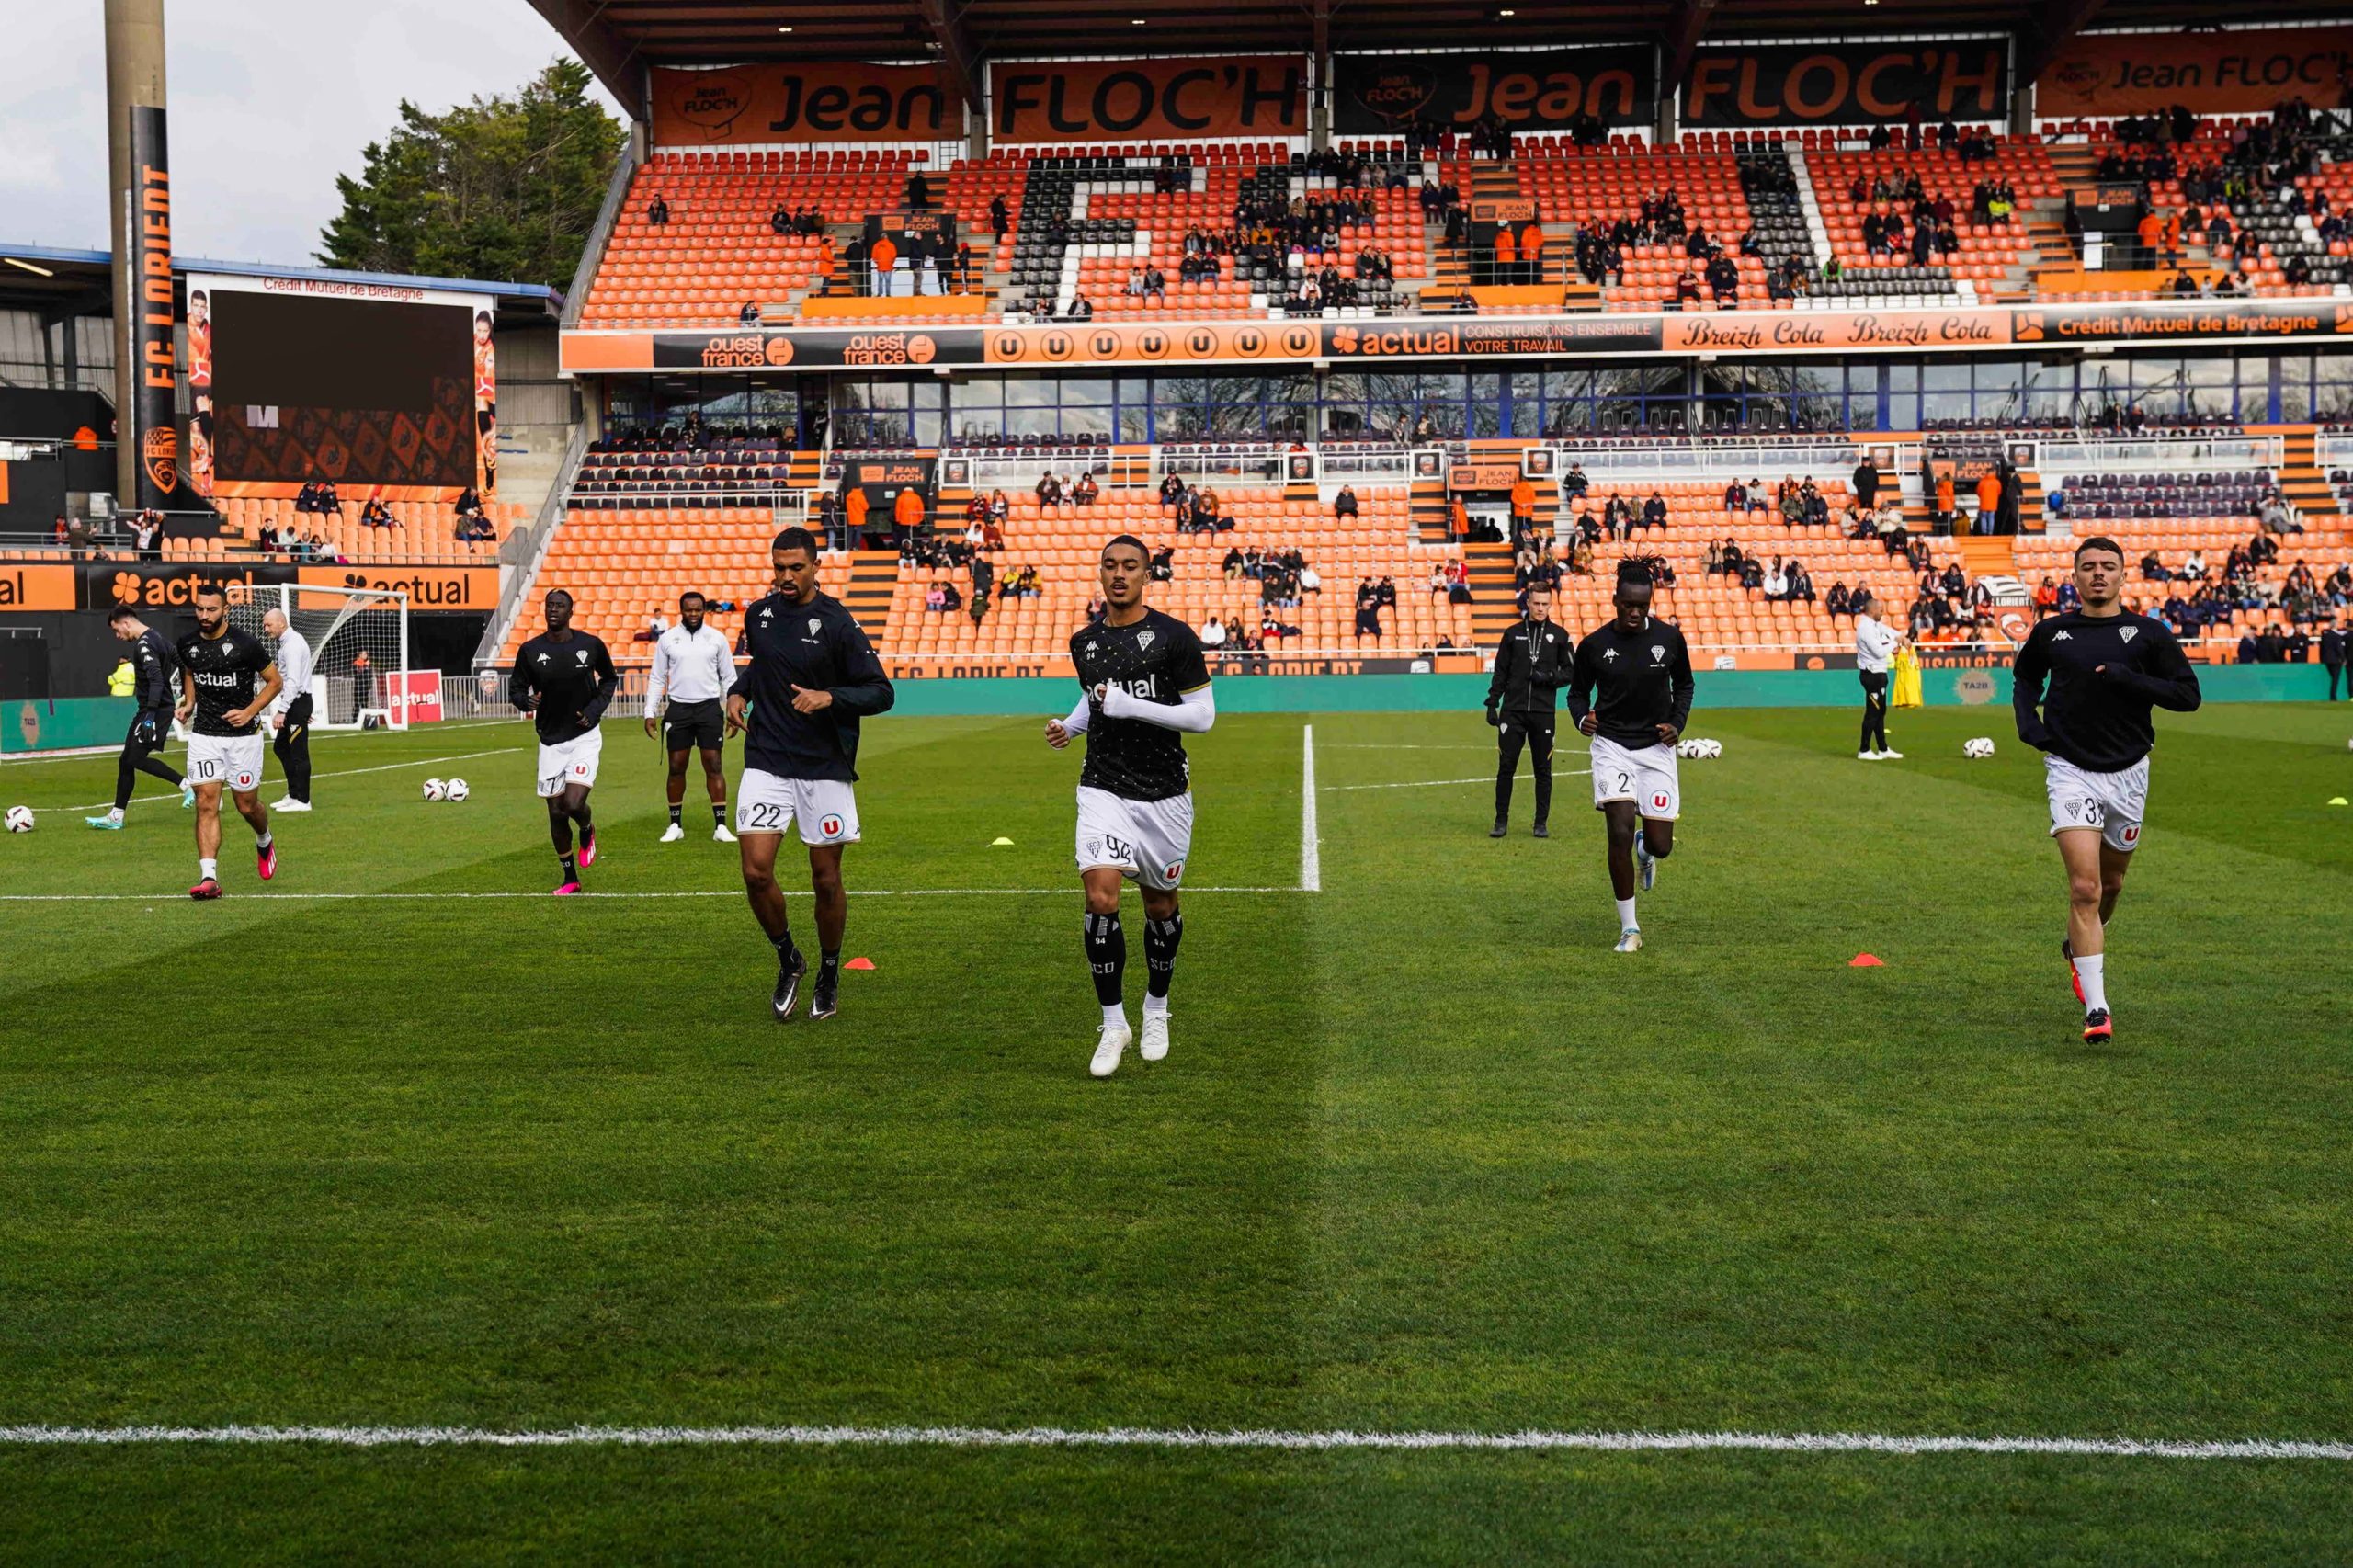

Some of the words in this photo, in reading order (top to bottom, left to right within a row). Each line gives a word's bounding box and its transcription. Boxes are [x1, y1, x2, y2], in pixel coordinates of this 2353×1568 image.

[1379, 75, 1410, 87] Jean
[1688, 50, 2000, 119] FLOC'H
[2111, 61, 2202, 89] Jean
[695, 87, 726, 98] Jean
[1000, 65, 1299, 134] FLOC'H
[1453, 63, 1634, 123] Jean
[770, 75, 945, 132] Jean
[142, 165, 174, 325] LORIENT
[305, 279, 347, 295] Mutuel
[350, 284, 365, 296] de
[369, 285, 424, 301] Bretagne
[1465, 324, 1574, 338] CONSTRUISONS
[1578, 322, 1651, 335] ENSEMBLE
[1682, 317, 1762, 349] Breizh
[1774, 319, 1825, 345] Cola
[1847, 313, 1928, 346] Breizh
[1940, 315, 1993, 341] Cola
[2058, 314, 2119, 335] Crédit
[2123, 313, 2193, 334] Mutuel
[2198, 312, 2222, 332] de
[2226, 312, 2318, 334] Bretagne
[709, 335, 764, 351] ouest
[850, 333, 905, 350] ouest
[1362, 324, 1460, 355] actual
[1465, 339, 1509, 353] VOTRE
[1512, 339, 1567, 353] TRAVAIL
[144, 340, 175, 389] FC
[702, 348, 764, 367] france
[843, 347, 905, 365] france
[892, 465, 920, 473] JEAN
[1086, 652, 1096, 660] 94
[197, 760, 215, 778] 10
[1618, 772, 1630, 793] 2
[1654, 795, 1667, 808] U
[2085, 797, 2104, 825] 3
[751, 802, 781, 828] 22
[824, 820, 839, 835] U
